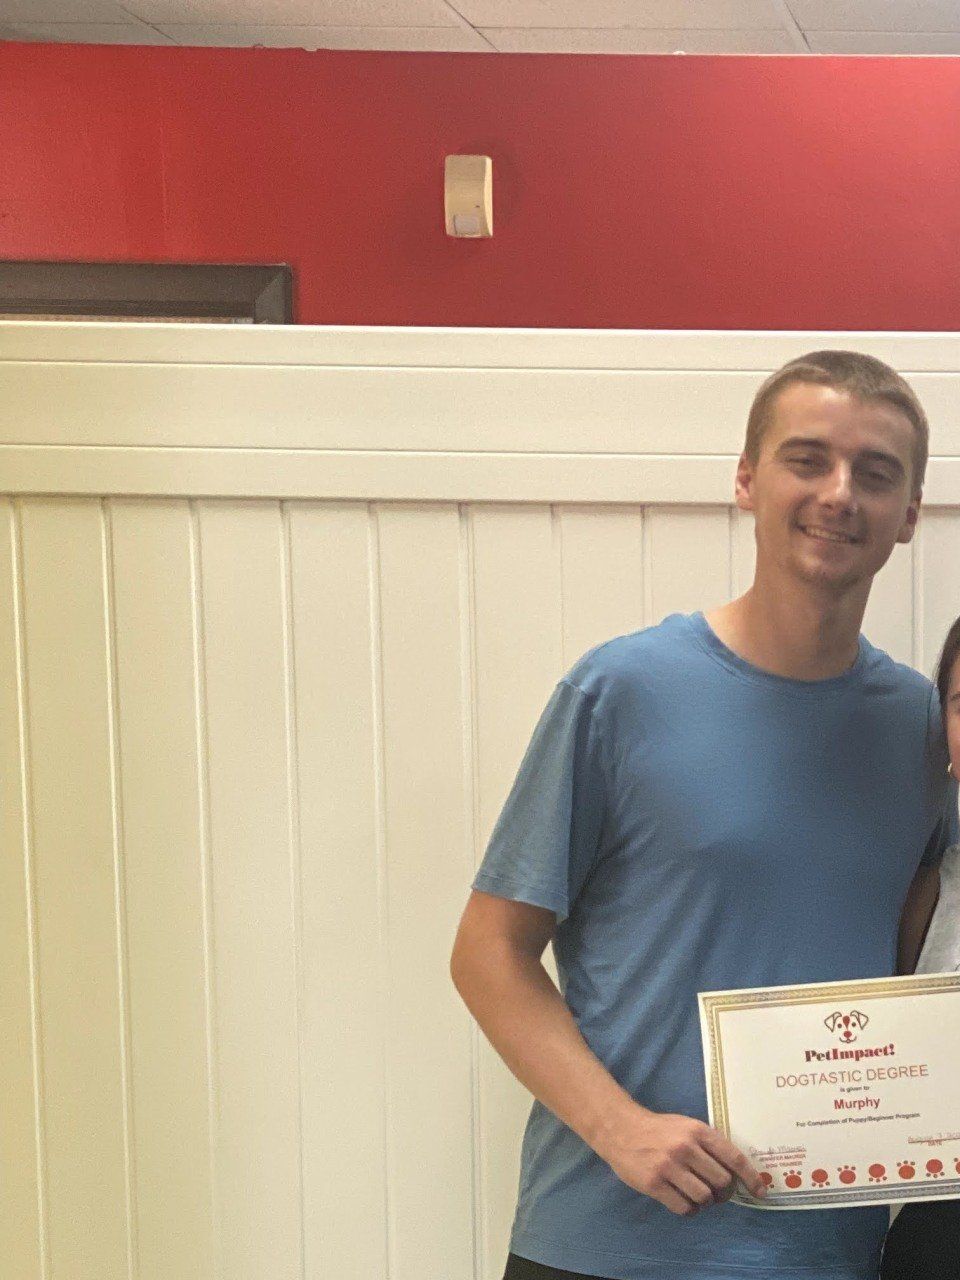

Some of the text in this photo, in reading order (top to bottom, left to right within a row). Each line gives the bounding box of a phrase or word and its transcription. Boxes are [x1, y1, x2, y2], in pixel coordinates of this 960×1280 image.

[805, 1043, 895, 1062] PetImpact!
[776, 1064, 929, 1088] DOGTASTIC DEGREE
[846, 1085, 862, 1093] given
[834, 1096, 880, 1110] Murphy
